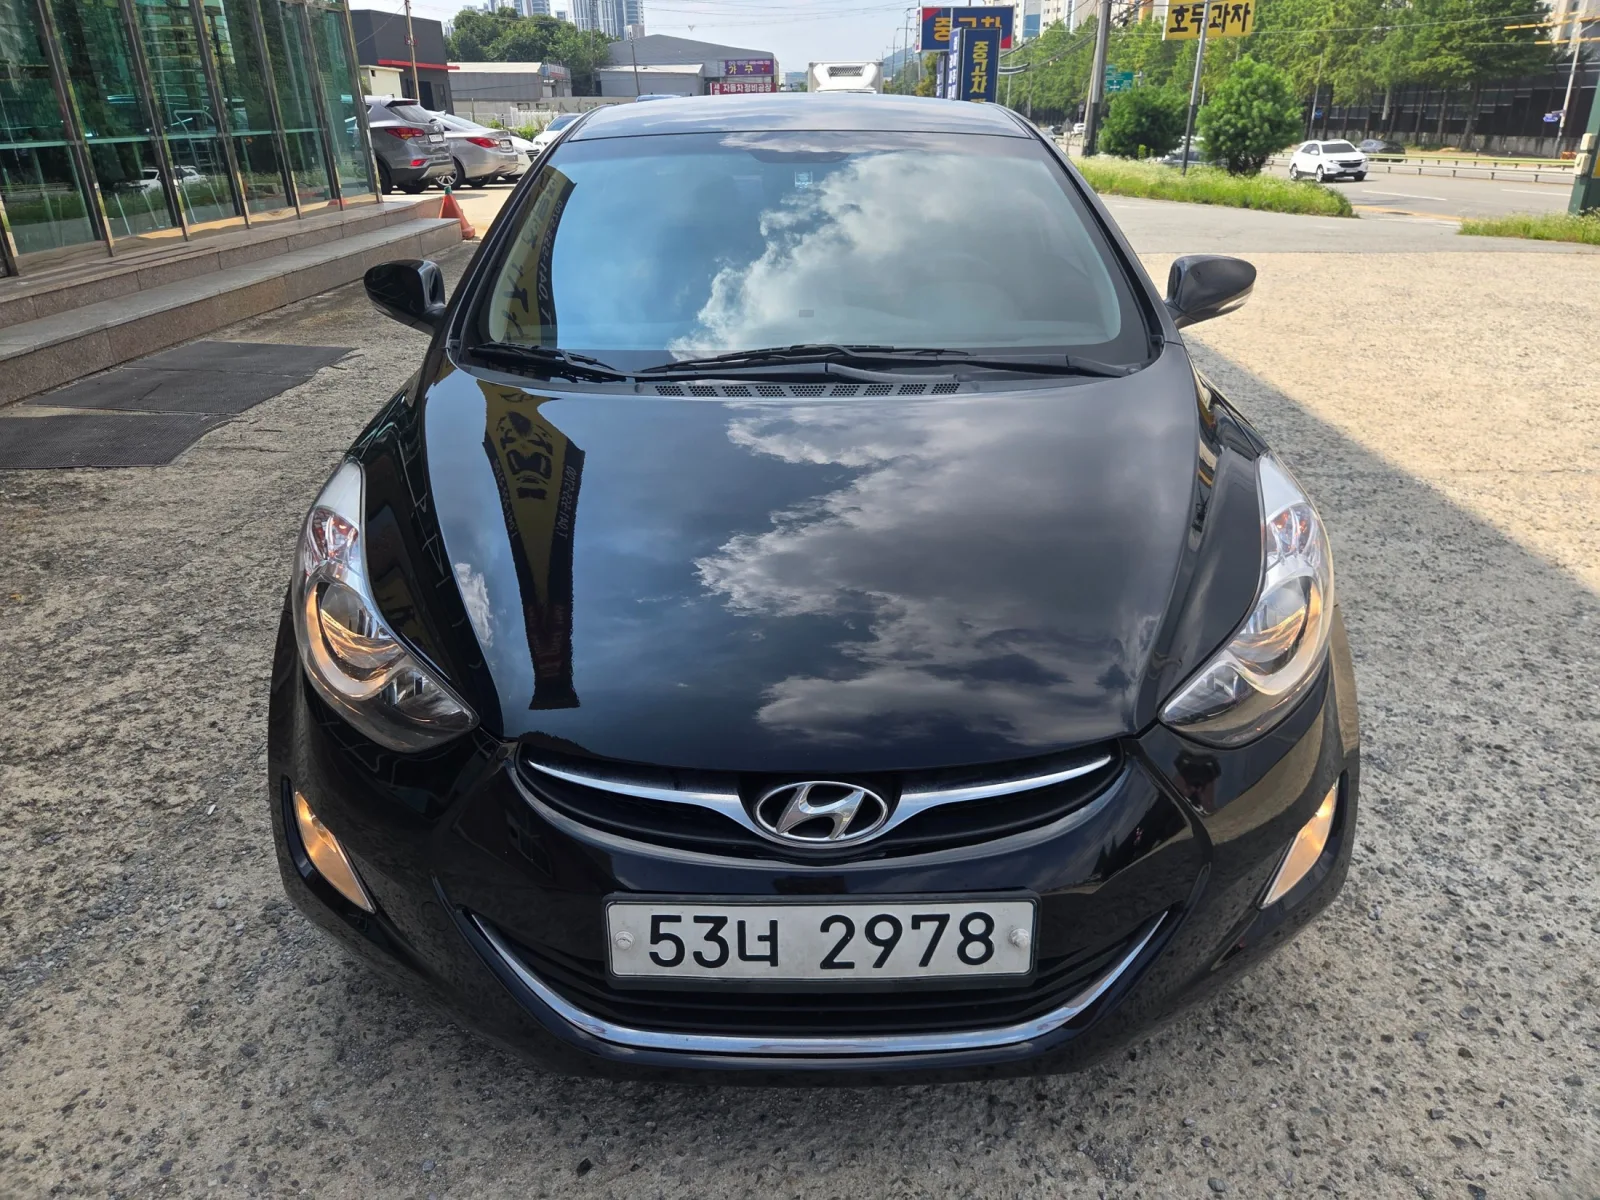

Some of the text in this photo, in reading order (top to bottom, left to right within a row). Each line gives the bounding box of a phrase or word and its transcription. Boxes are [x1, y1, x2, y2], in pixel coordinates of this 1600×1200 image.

[1168, 2, 1251, 34] 호두과자
[969, 41, 989, 93] 중고차
[649, 911, 996, 970] 53너 2978
